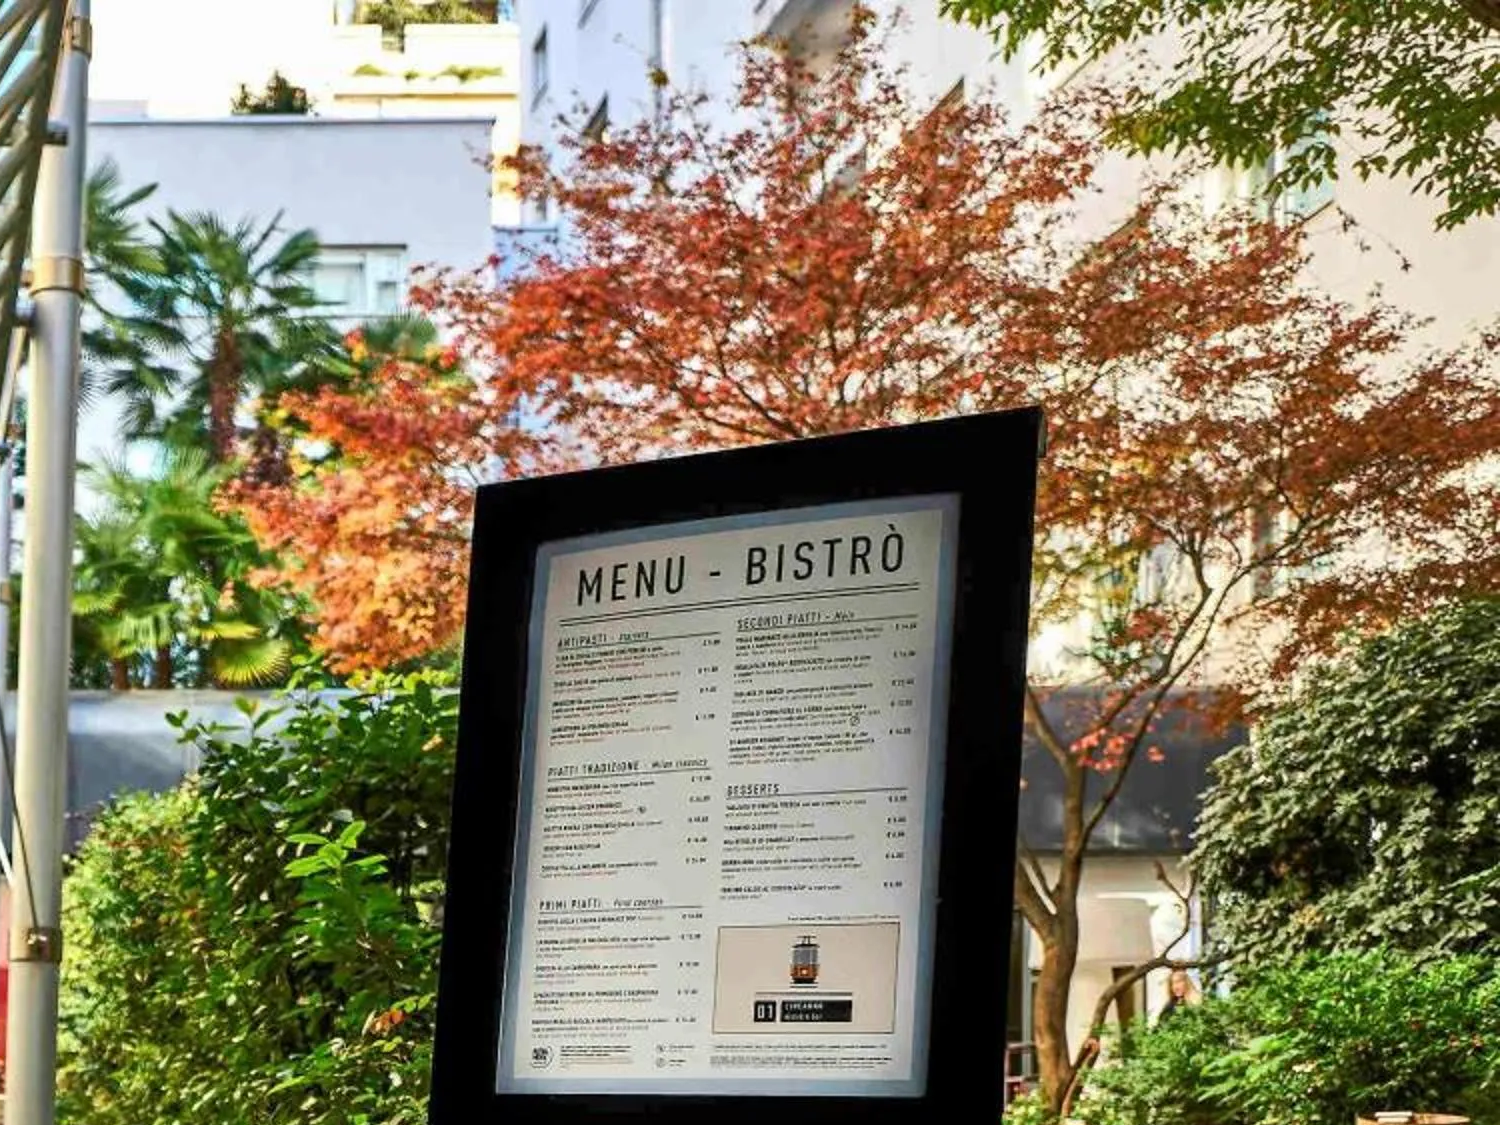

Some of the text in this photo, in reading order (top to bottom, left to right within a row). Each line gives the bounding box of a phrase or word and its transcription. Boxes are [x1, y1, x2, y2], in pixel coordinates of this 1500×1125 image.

[576, 555, 686, 606] MENU
[745, 524, 905, 586] BISTRÒ
[737, 615, 783, 630] SECONDI
[787, 611, 821, 624] PIATTI
[557, 633, 607, 647] ANTIPASTI
[548, 765, 579, 777] PIATTI
[582, 761, 640, 773] TRADIZIONE
[727, 783, 780, 796] DESSERTS
[539, 900, 567, 911] PRIMI
[571, 898, 601, 909] PIATTI
[757, 1004, 773, 1019] 01
